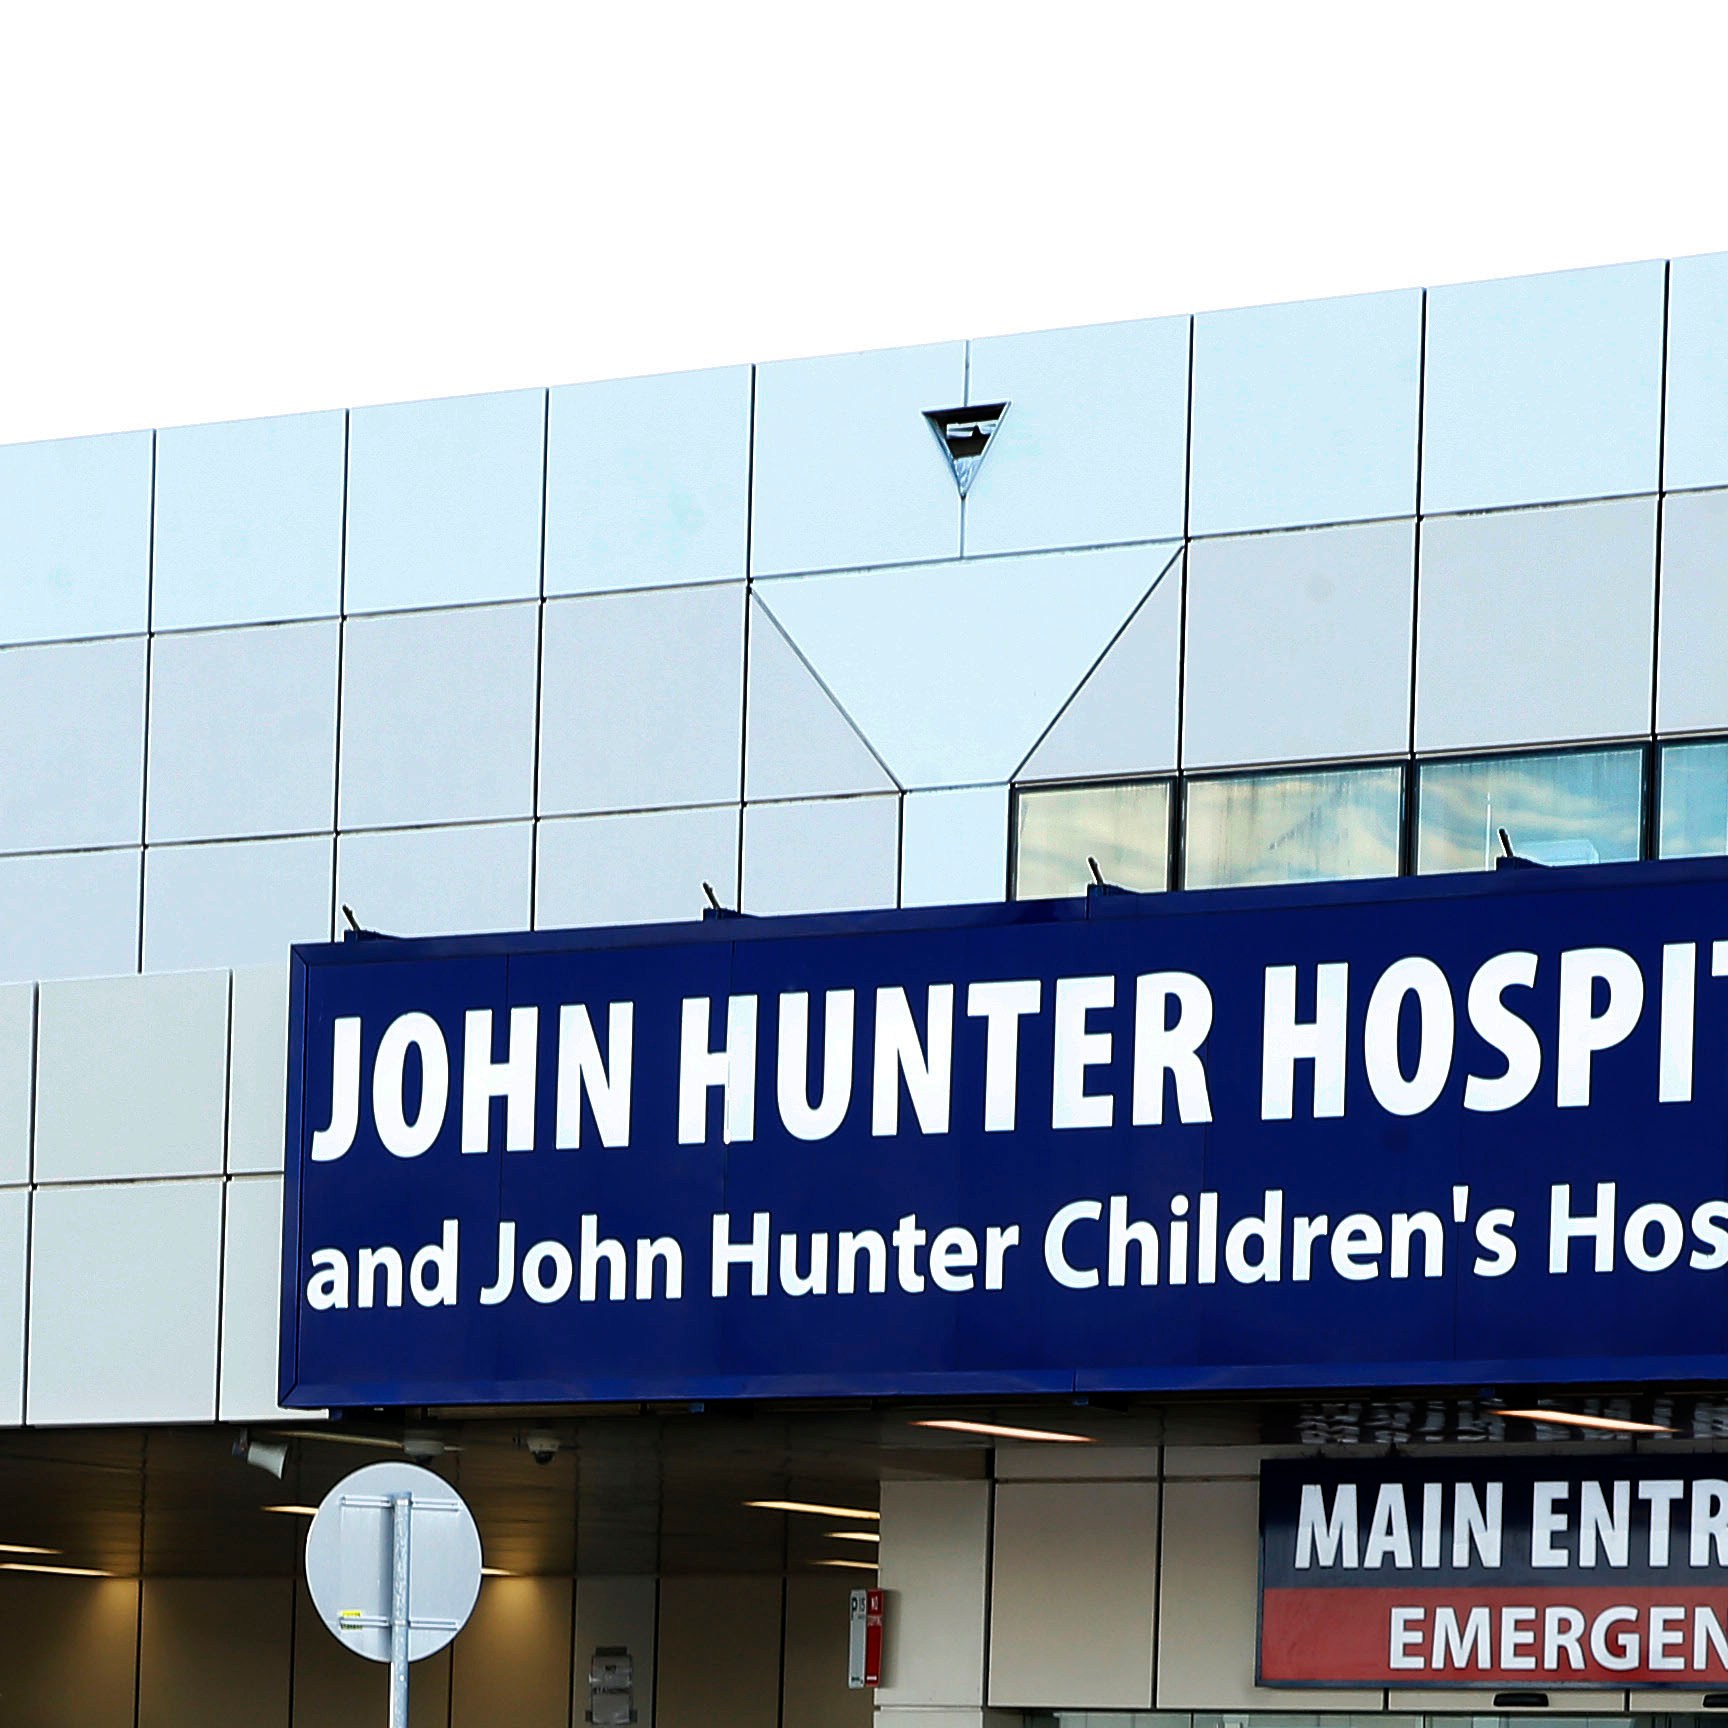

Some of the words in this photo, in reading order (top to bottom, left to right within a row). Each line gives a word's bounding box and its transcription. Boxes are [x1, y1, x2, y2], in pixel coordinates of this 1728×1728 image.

[311, 1001, 634, 1162] JOHN
[678, 970, 1213, 1146] HUNTER
[306, 1218, 459, 1311] and
[479, 1214, 683, 1306] John
[711, 1212, 1020, 1300] Hunter
[1044, 1185, 1517, 1289] Children's
[1294, 1483, 1503, 1570] MAIN
